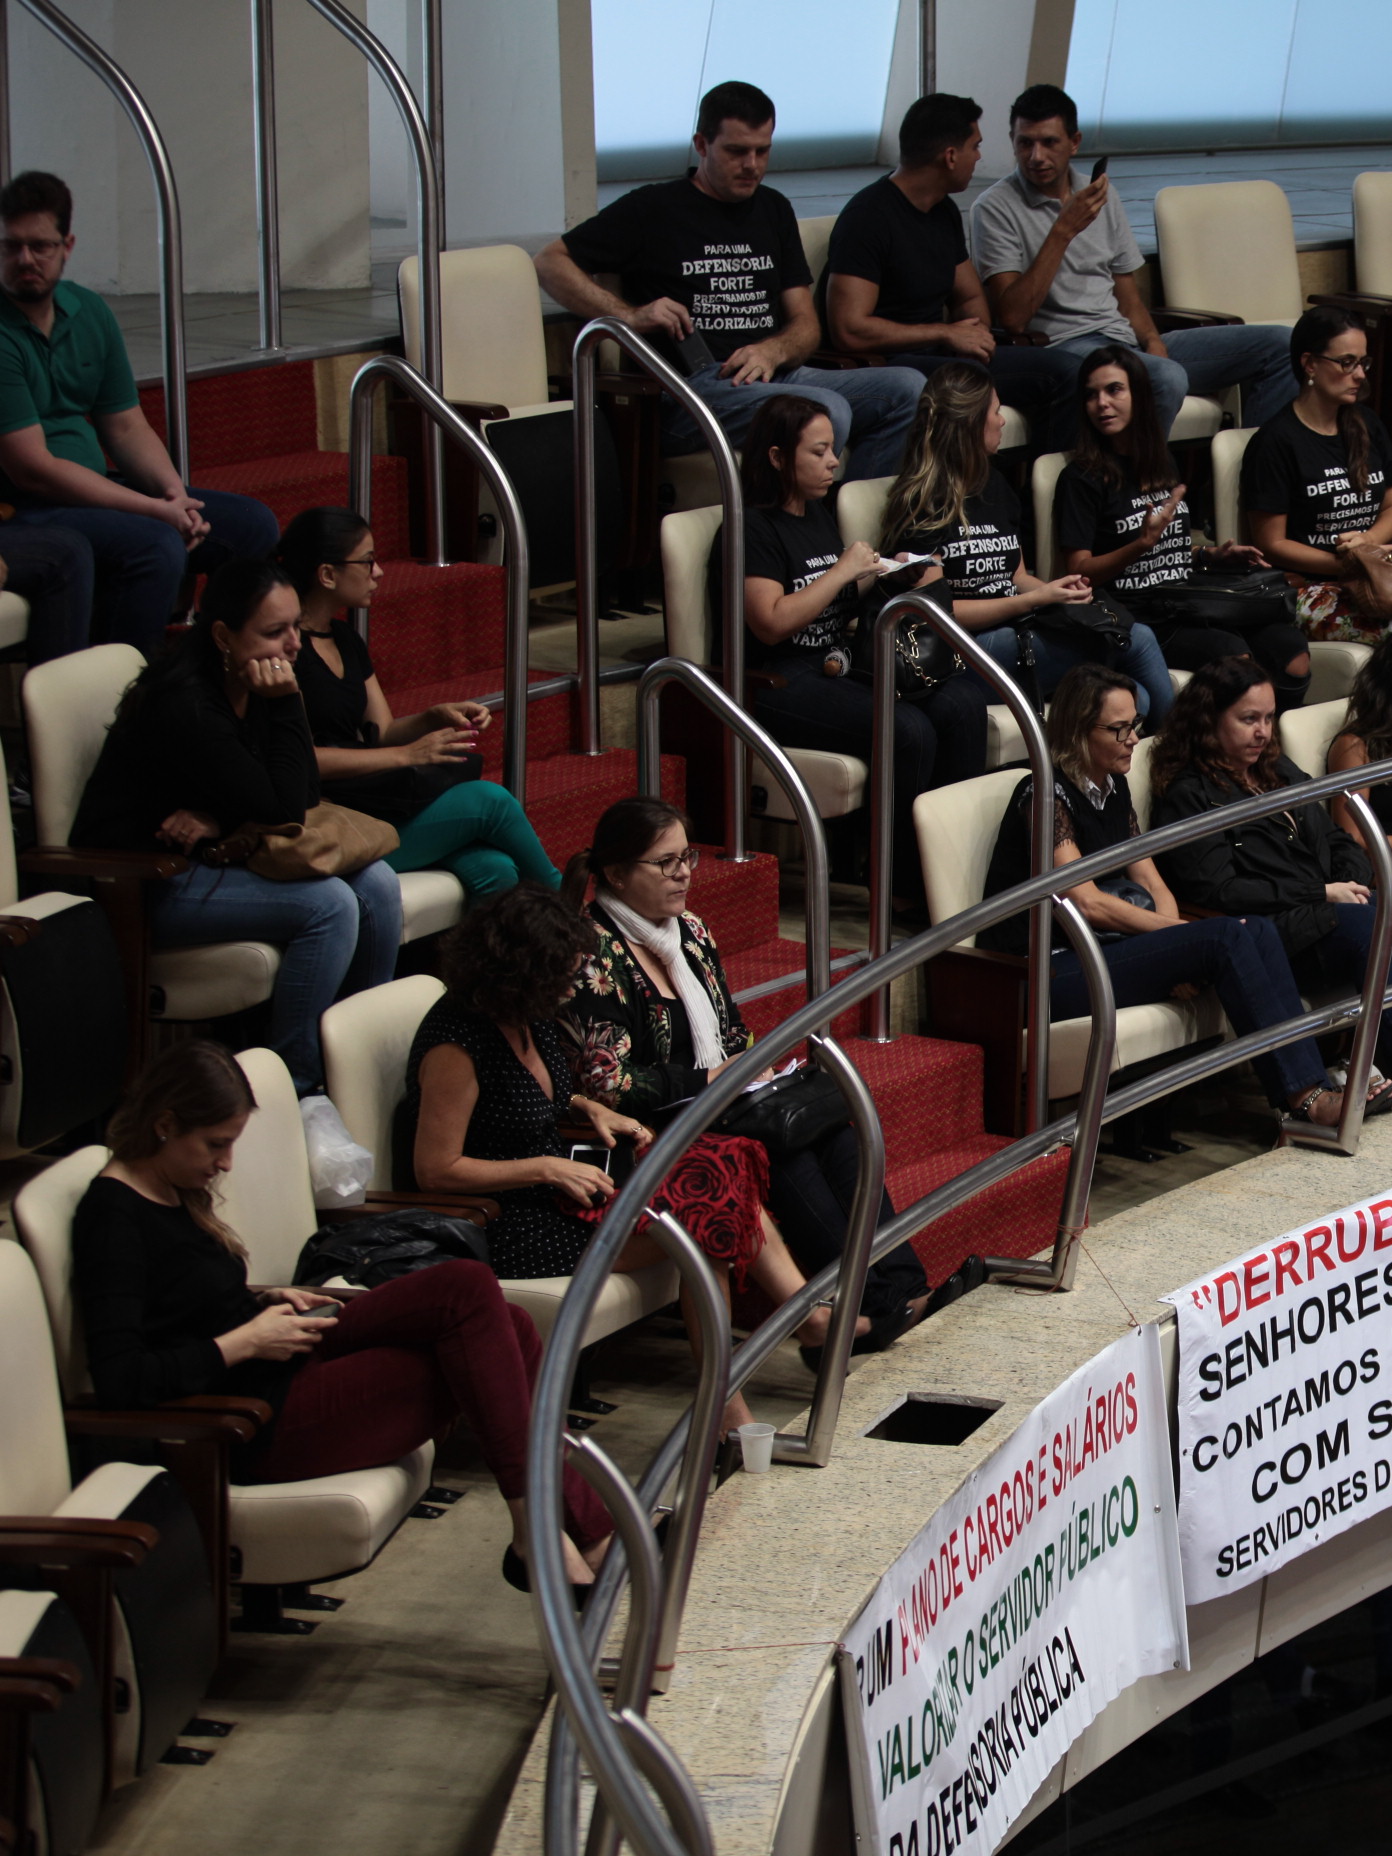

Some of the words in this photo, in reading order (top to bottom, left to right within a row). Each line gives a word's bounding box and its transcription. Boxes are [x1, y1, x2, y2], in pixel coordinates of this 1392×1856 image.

[704, 244, 731, 255] PARA
[731, 244, 752, 254] UMA
[682, 255, 774, 276] DEFENSORIA
[710, 276, 754, 291] FORTE
[693, 292, 755, 304] PRECISAMOS
[690, 315, 774, 330] ALORIZADOS!
[1306, 470, 1385, 497] DEFENRIA
[1131, 494, 1152, 509] PARA
[1151, 490, 1172, 502] UMA
[1317, 505, 1372, 520] PRECISAMOS
[981, 524, 999, 535] UMA
[1160, 519, 1183, 538] RTE
[806, 557, 826, 569] PARA
[823, 554, 839, 565] UMA
[965, 556, 1006, 575] FORTE
[1124, 552, 1192, 575] SERVIDORE
[1114, 567, 1193, 590] VALORIZADO
[1192, 1348, 1381, 1472] CONTAMOS
[1252, 1418, 1351, 1504] COM
[898, 1558, 938, 1676] PLANO
[939, 1529, 963, 1612] DE
[964, 1459, 1034, 1582] CARGOS
[1038, 1444, 1047, 1512] E
[1052, 1372, 1138, 1497] SALÁRIOS
[1216, 1470, 1368, 1578] SERVIDORES
[963, 1629, 975, 1696] O
[979, 1543, 1055, 1679] SERVIDOR
[1059, 1475, 1139, 1594] PÚBLICO
[927, 1702, 1019, 1856] DEFENSORIA
[1011, 1626, 1085, 1752] PÚBLICA
